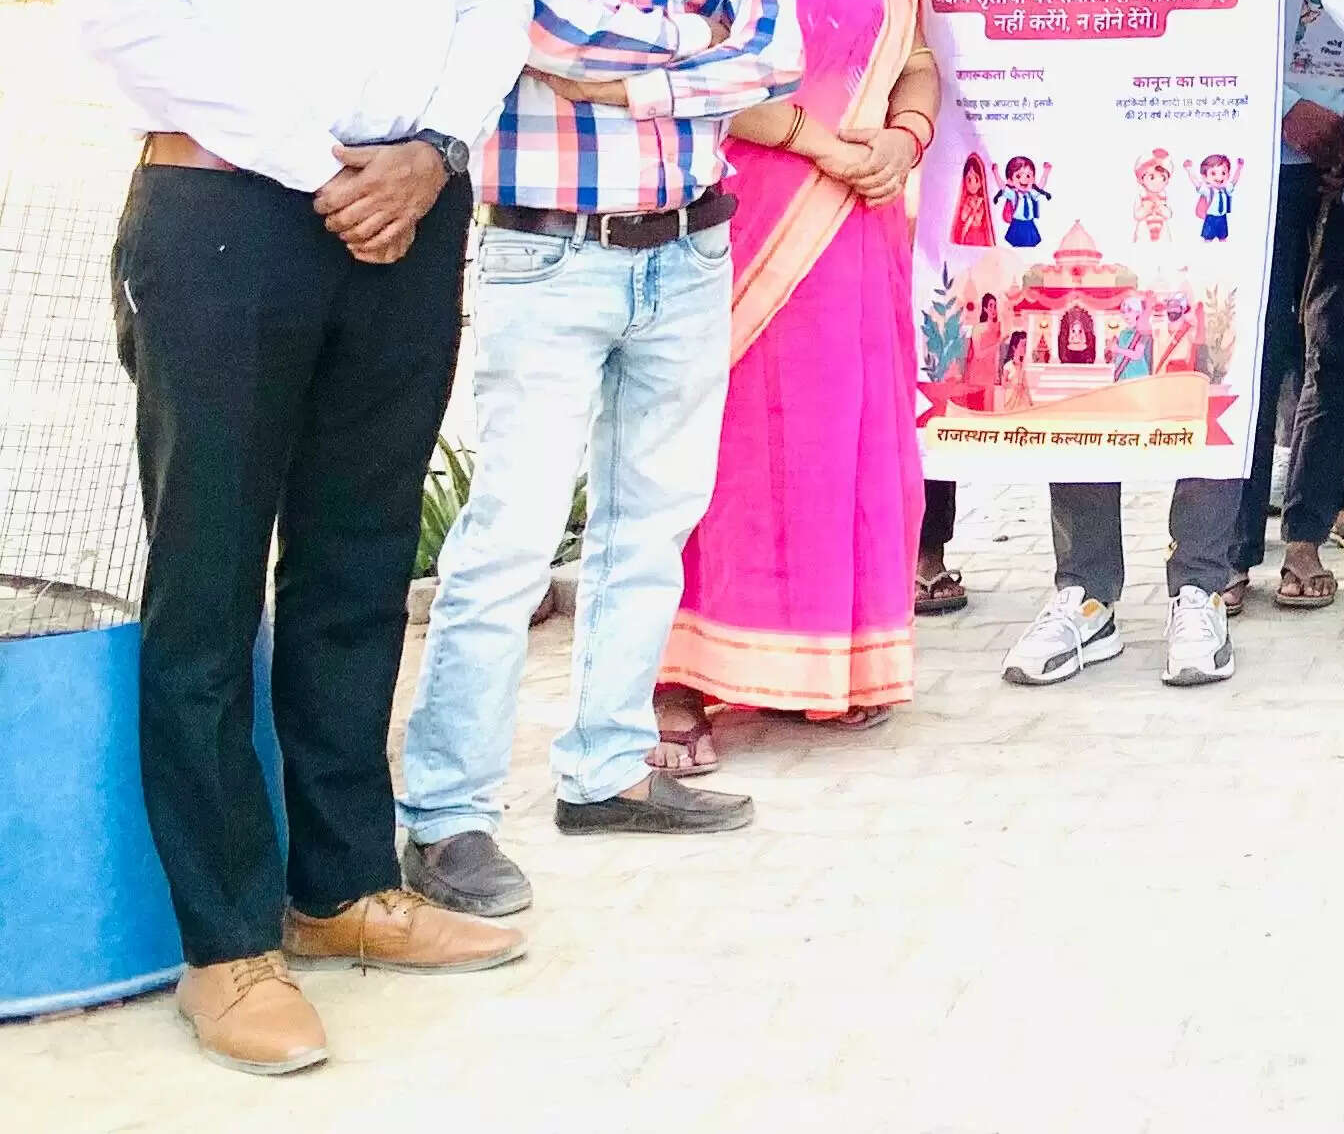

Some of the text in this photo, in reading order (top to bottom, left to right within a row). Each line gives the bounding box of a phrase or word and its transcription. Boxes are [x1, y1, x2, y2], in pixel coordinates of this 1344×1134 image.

[993, 7, 1158, 34] नहीं करेंगे, न होने देंगे।
[1132, 76, 1239, 92] कानून का पालन
[1138, 110, 1147, 120] 21
[937, 427, 999, 446] राजस्थान
[1003, 426, 1046, 446] महिला
[1050, 429, 1102, 447] कल्याण
[1106, 427, 1139, 447] मंडल
